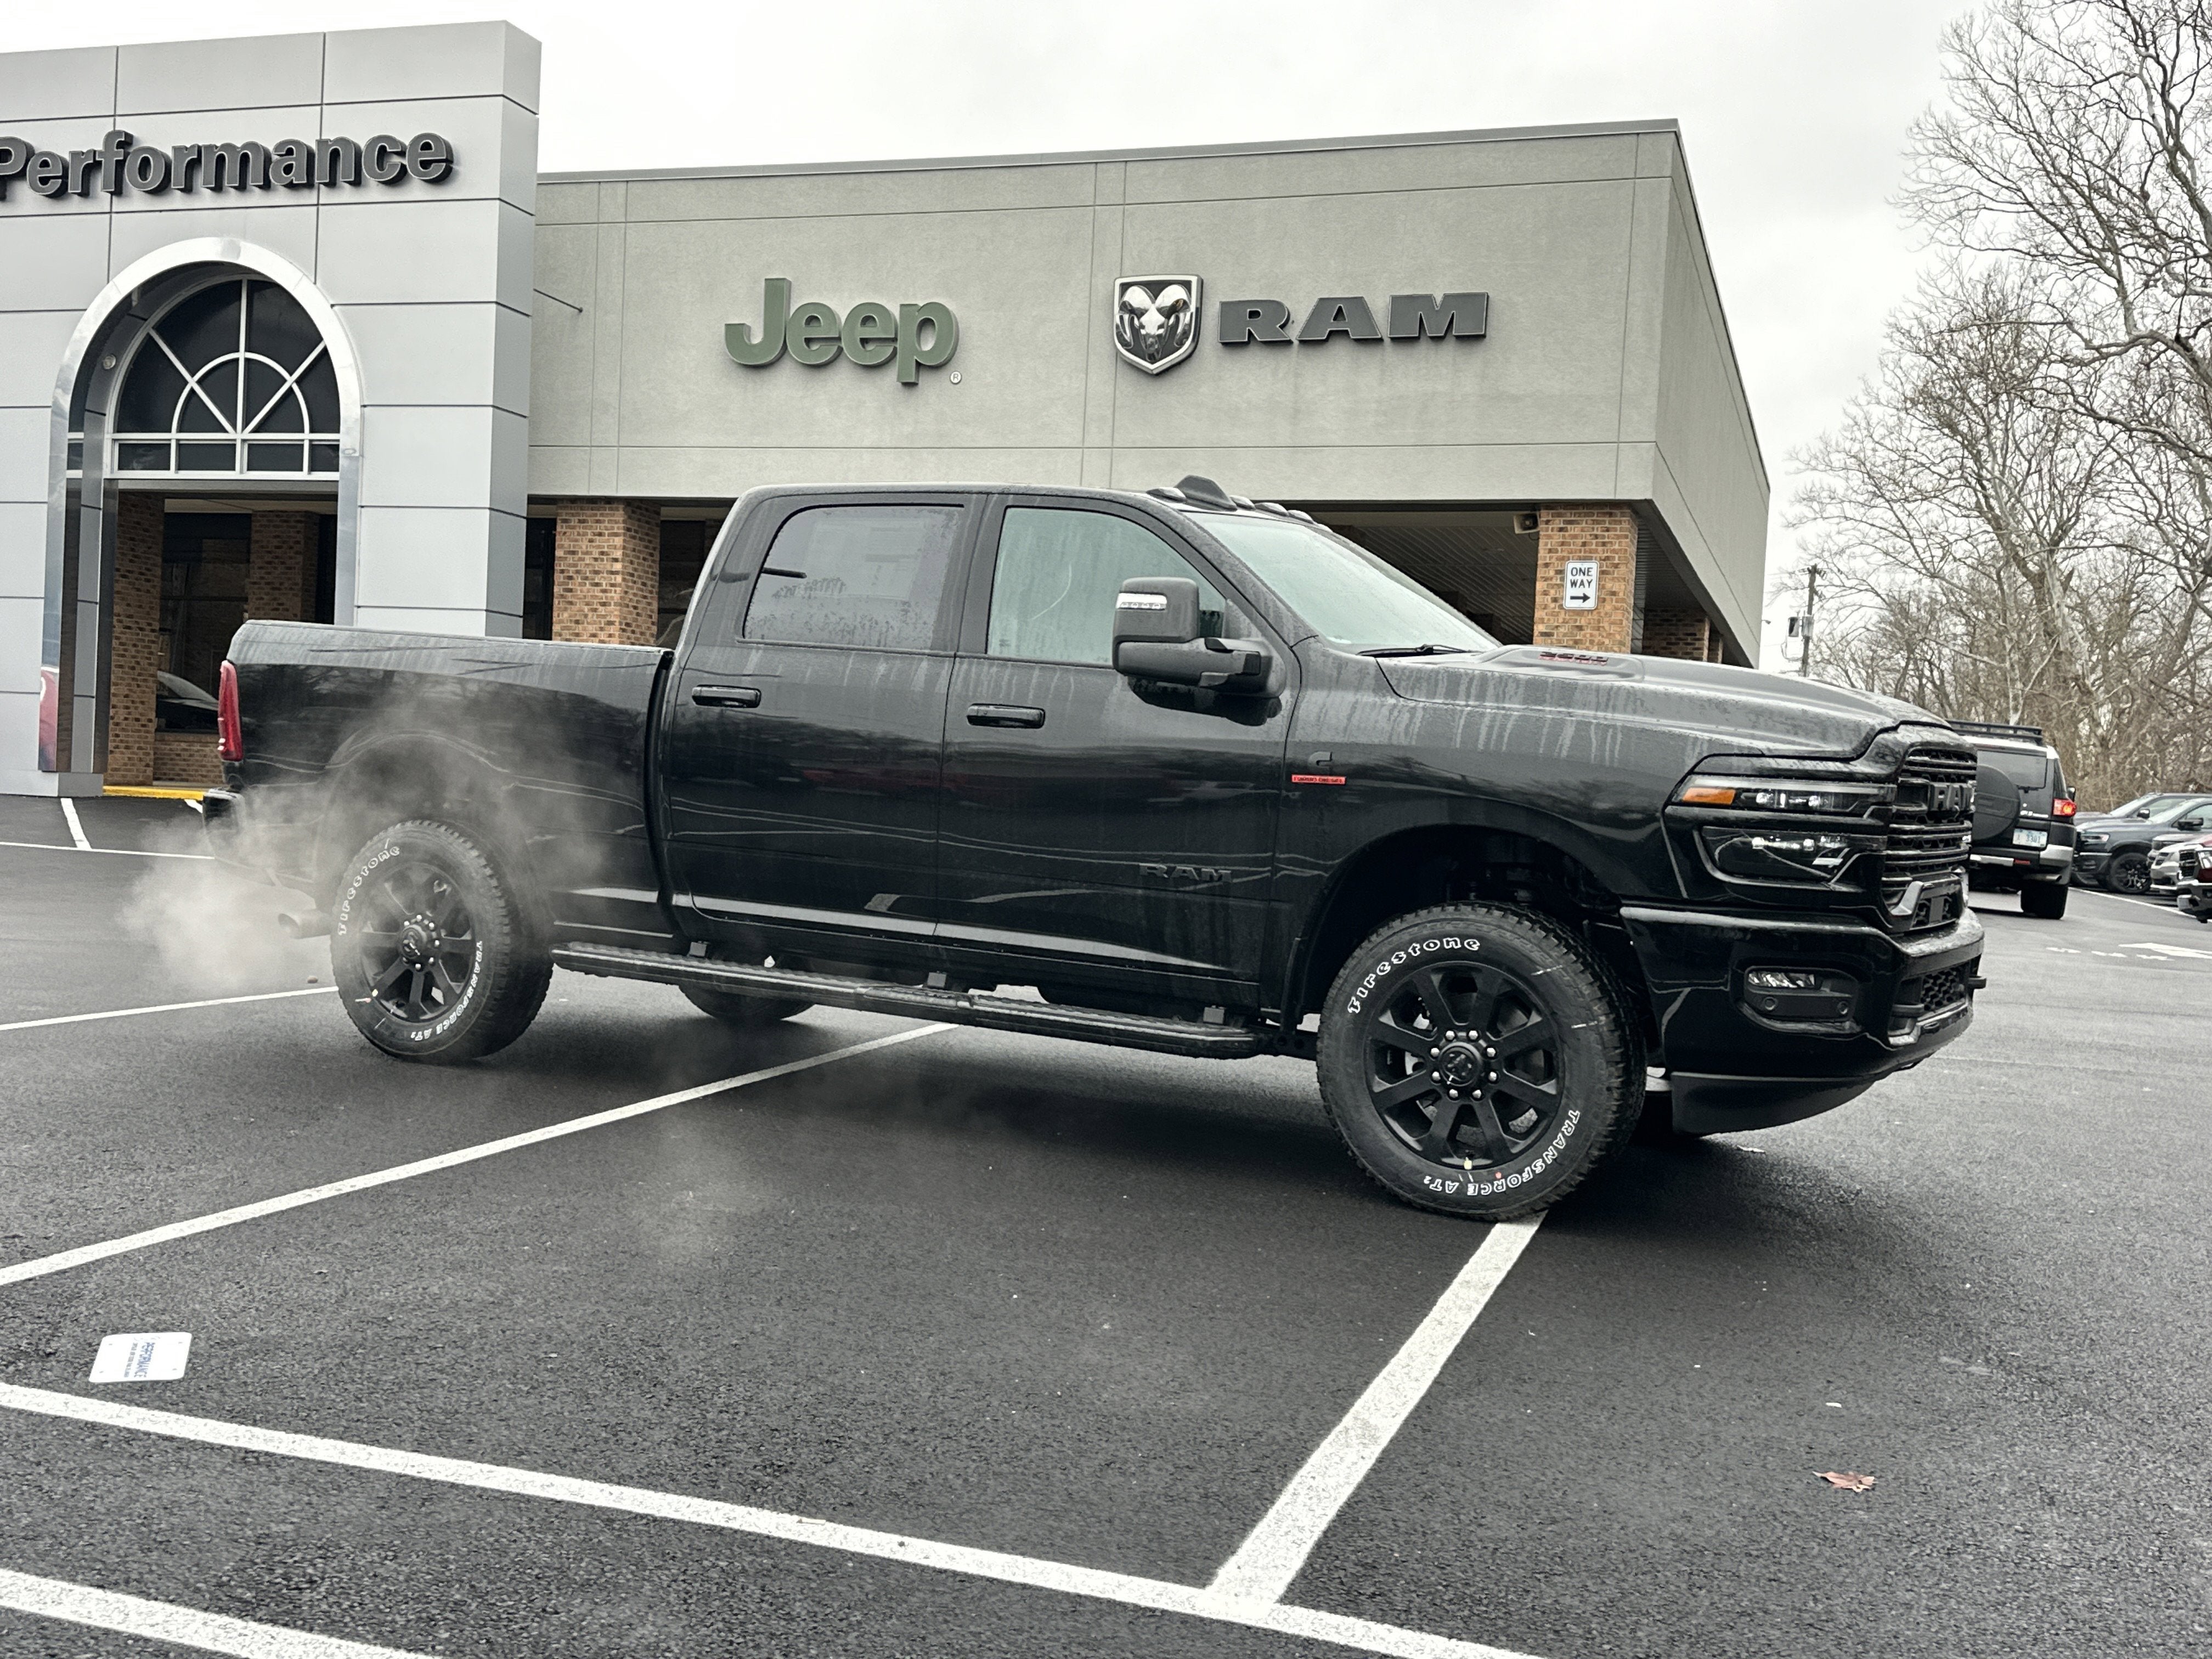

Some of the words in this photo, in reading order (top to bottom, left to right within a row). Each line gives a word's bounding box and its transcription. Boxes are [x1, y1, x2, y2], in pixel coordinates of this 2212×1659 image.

[0, 129, 452, 198] Performance
[724, 277, 959, 385] Jeep
[1218, 292, 1489, 345] RAM
[1570, 567, 1594, 577] ONE
[1570, 578, 1593, 589] WAY
[1139, 862, 1232, 882] RAM
[436, 940, 483, 1035] TRANSFORCE
[1347, 936, 1481, 1014] Firestone
[1466, 1109, 1581, 1196] TRANSFORCE
